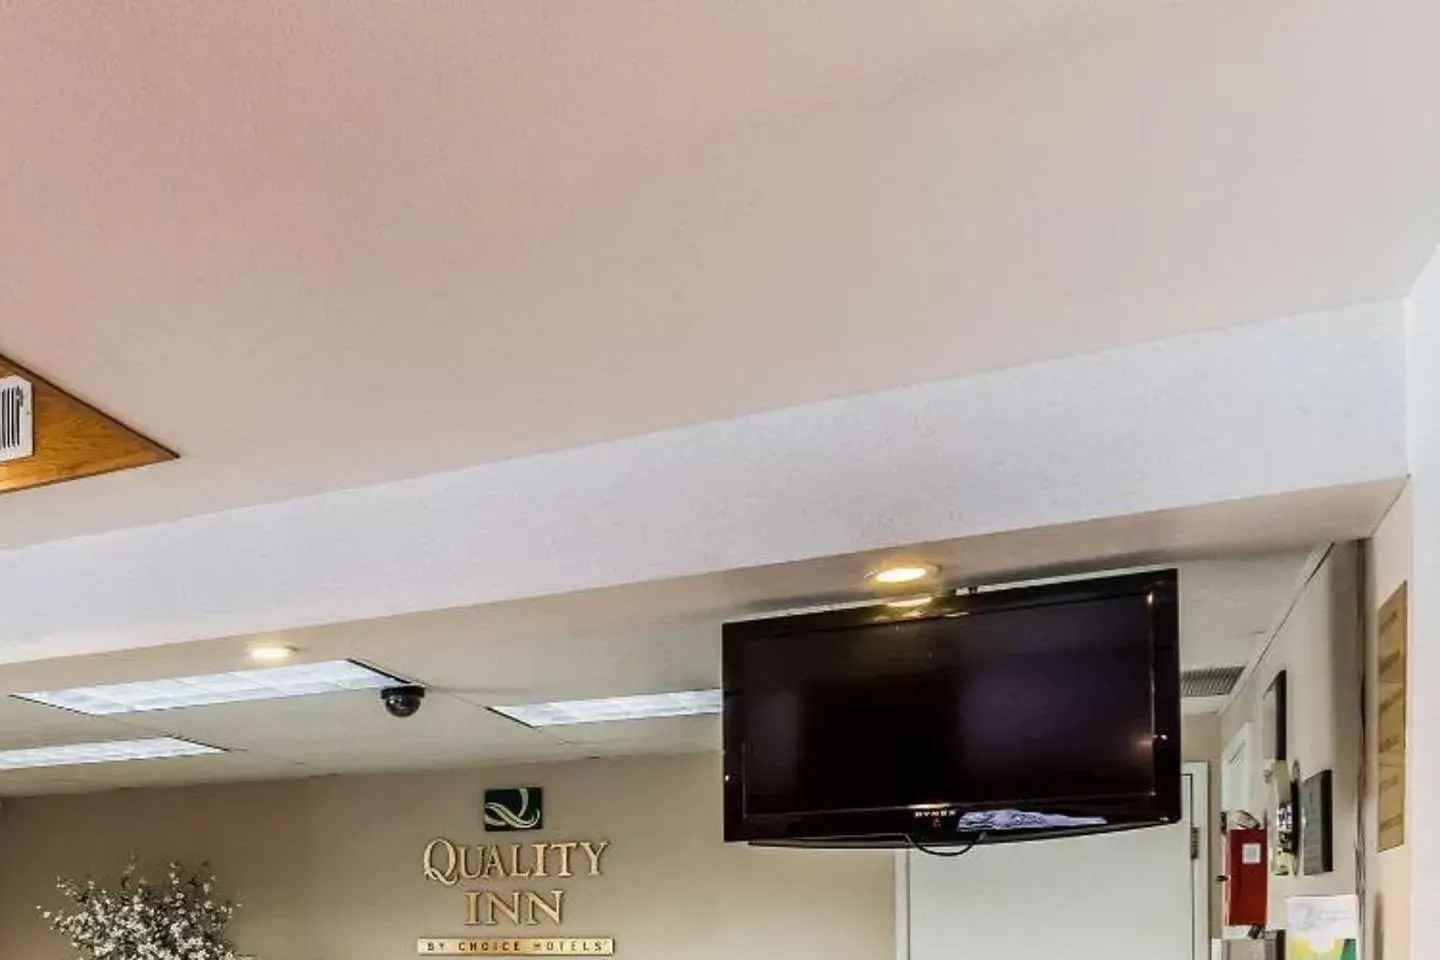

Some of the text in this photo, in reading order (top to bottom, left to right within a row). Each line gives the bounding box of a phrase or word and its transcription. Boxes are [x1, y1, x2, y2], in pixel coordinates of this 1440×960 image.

[423, 838, 608, 885] QUALITY
[464, 889, 565, 925] INN
[426, 941, 603, 952] BY CHOICE HOTELS
